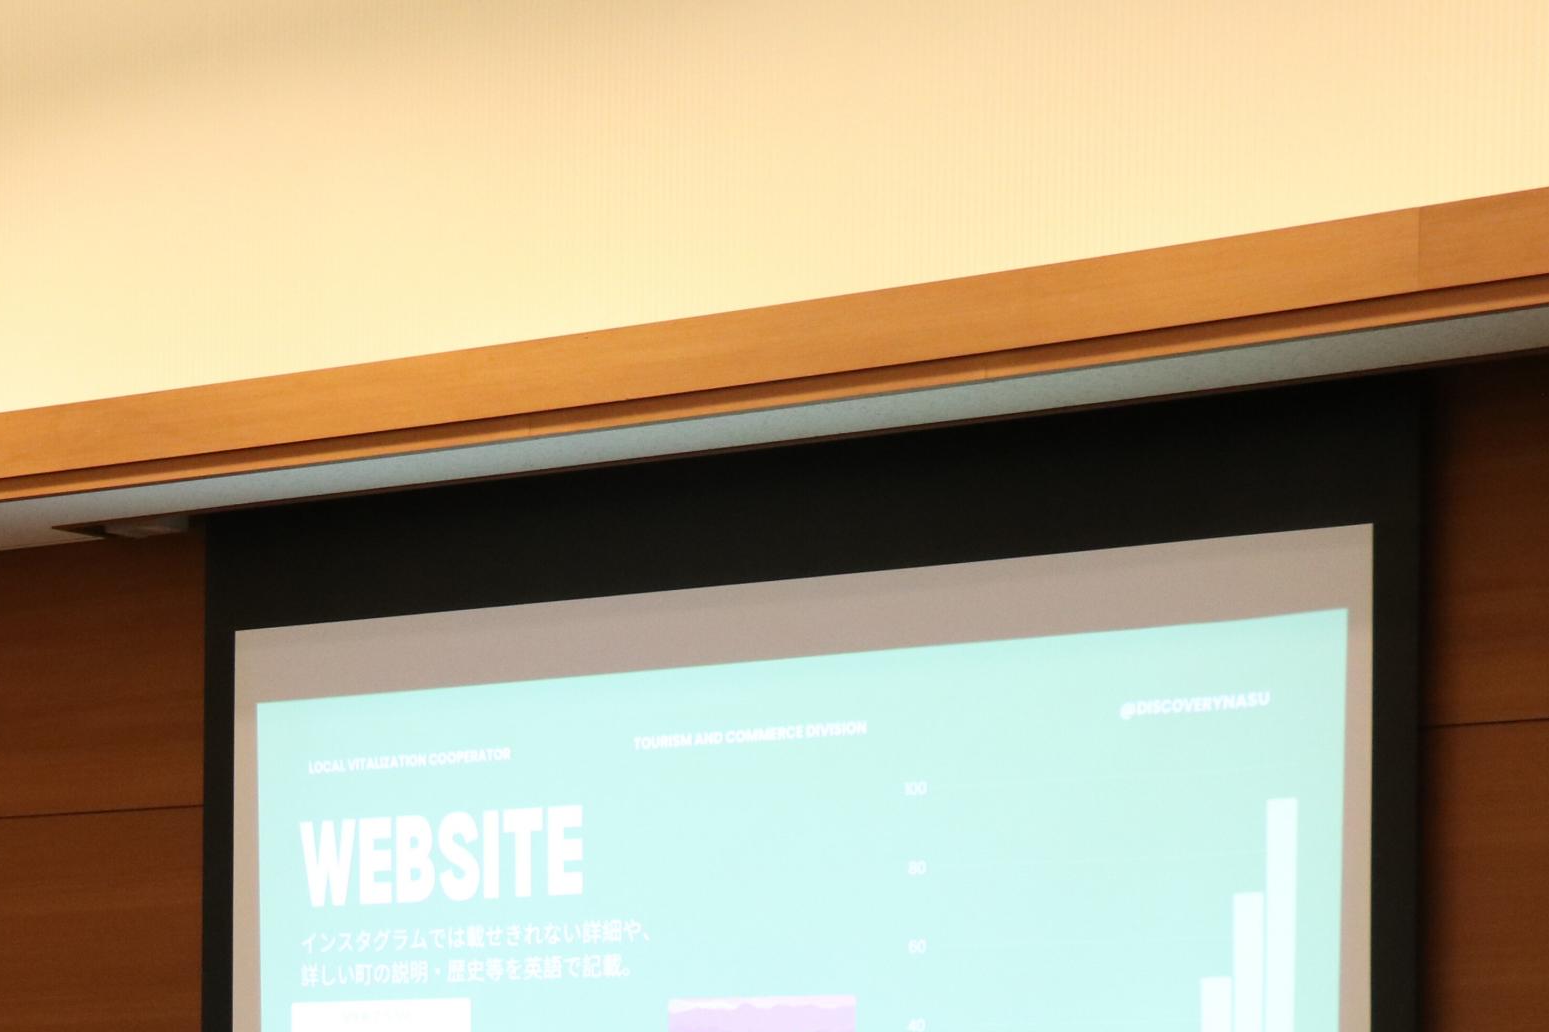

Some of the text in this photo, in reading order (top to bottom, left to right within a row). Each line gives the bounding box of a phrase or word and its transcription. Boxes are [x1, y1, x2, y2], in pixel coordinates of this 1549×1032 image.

[1119, 691, 1271, 719] @DISCOVERYNASU
[633, 721, 868, 751] TOURISM AND COMMERCE DIVISION
[308, 759, 345, 775] LOCAL
[428, 747, 511, 766] COOPERATOR
[300, 805, 583, 907] WEBSITE
